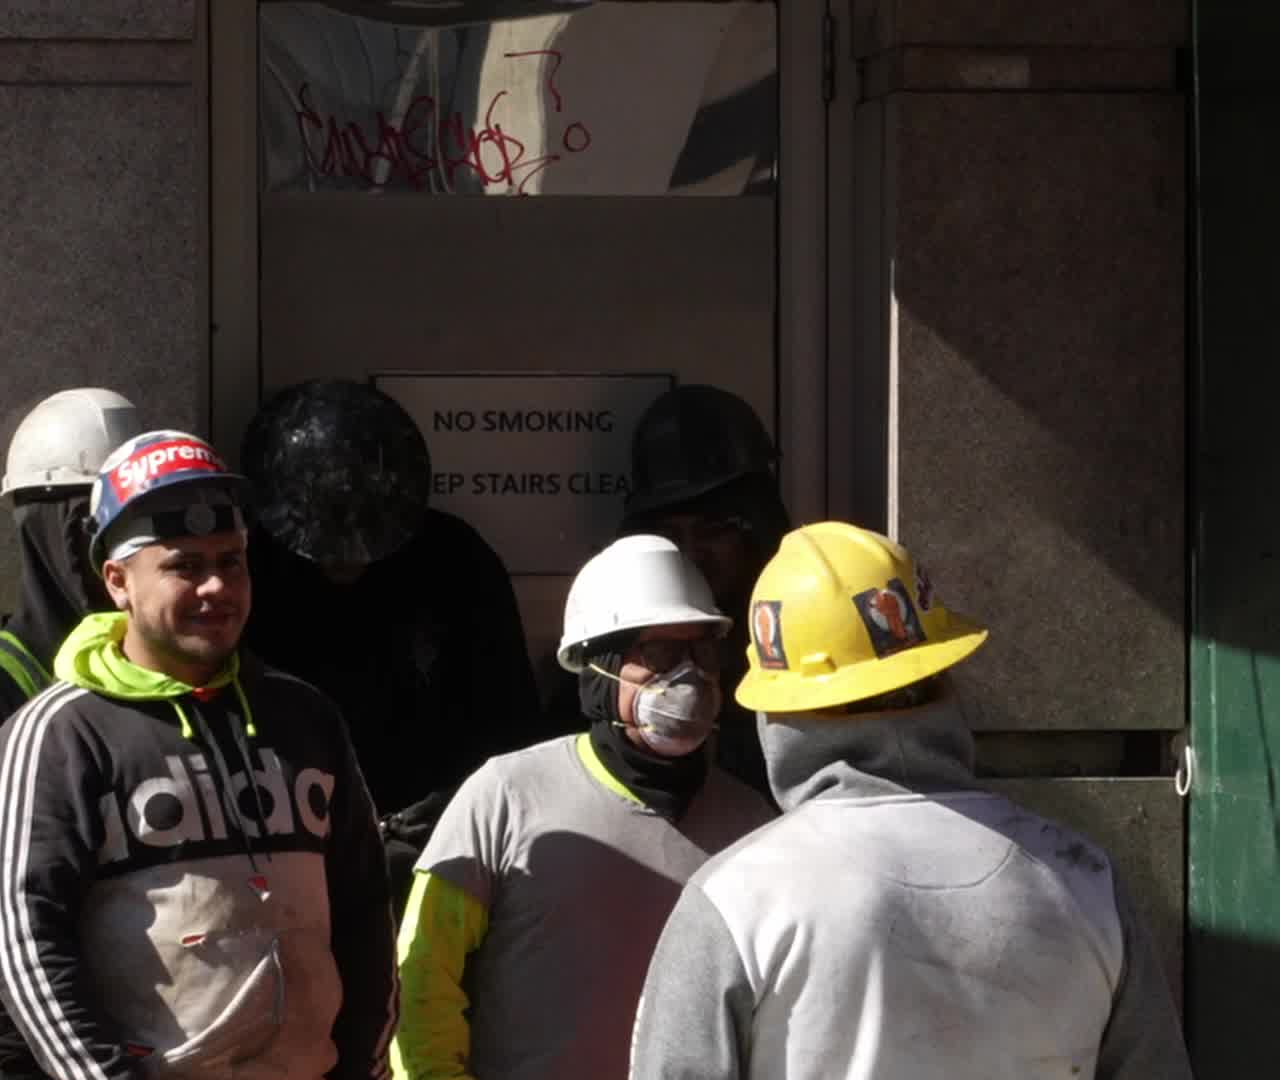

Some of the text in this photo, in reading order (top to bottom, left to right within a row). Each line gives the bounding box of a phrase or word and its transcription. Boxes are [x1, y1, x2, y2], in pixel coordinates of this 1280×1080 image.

[433, 411, 614, 432] NO SMOKING
[117, 446, 225, 488] Suprem
[433, 473, 631, 495] EP STAIRS CLEA
